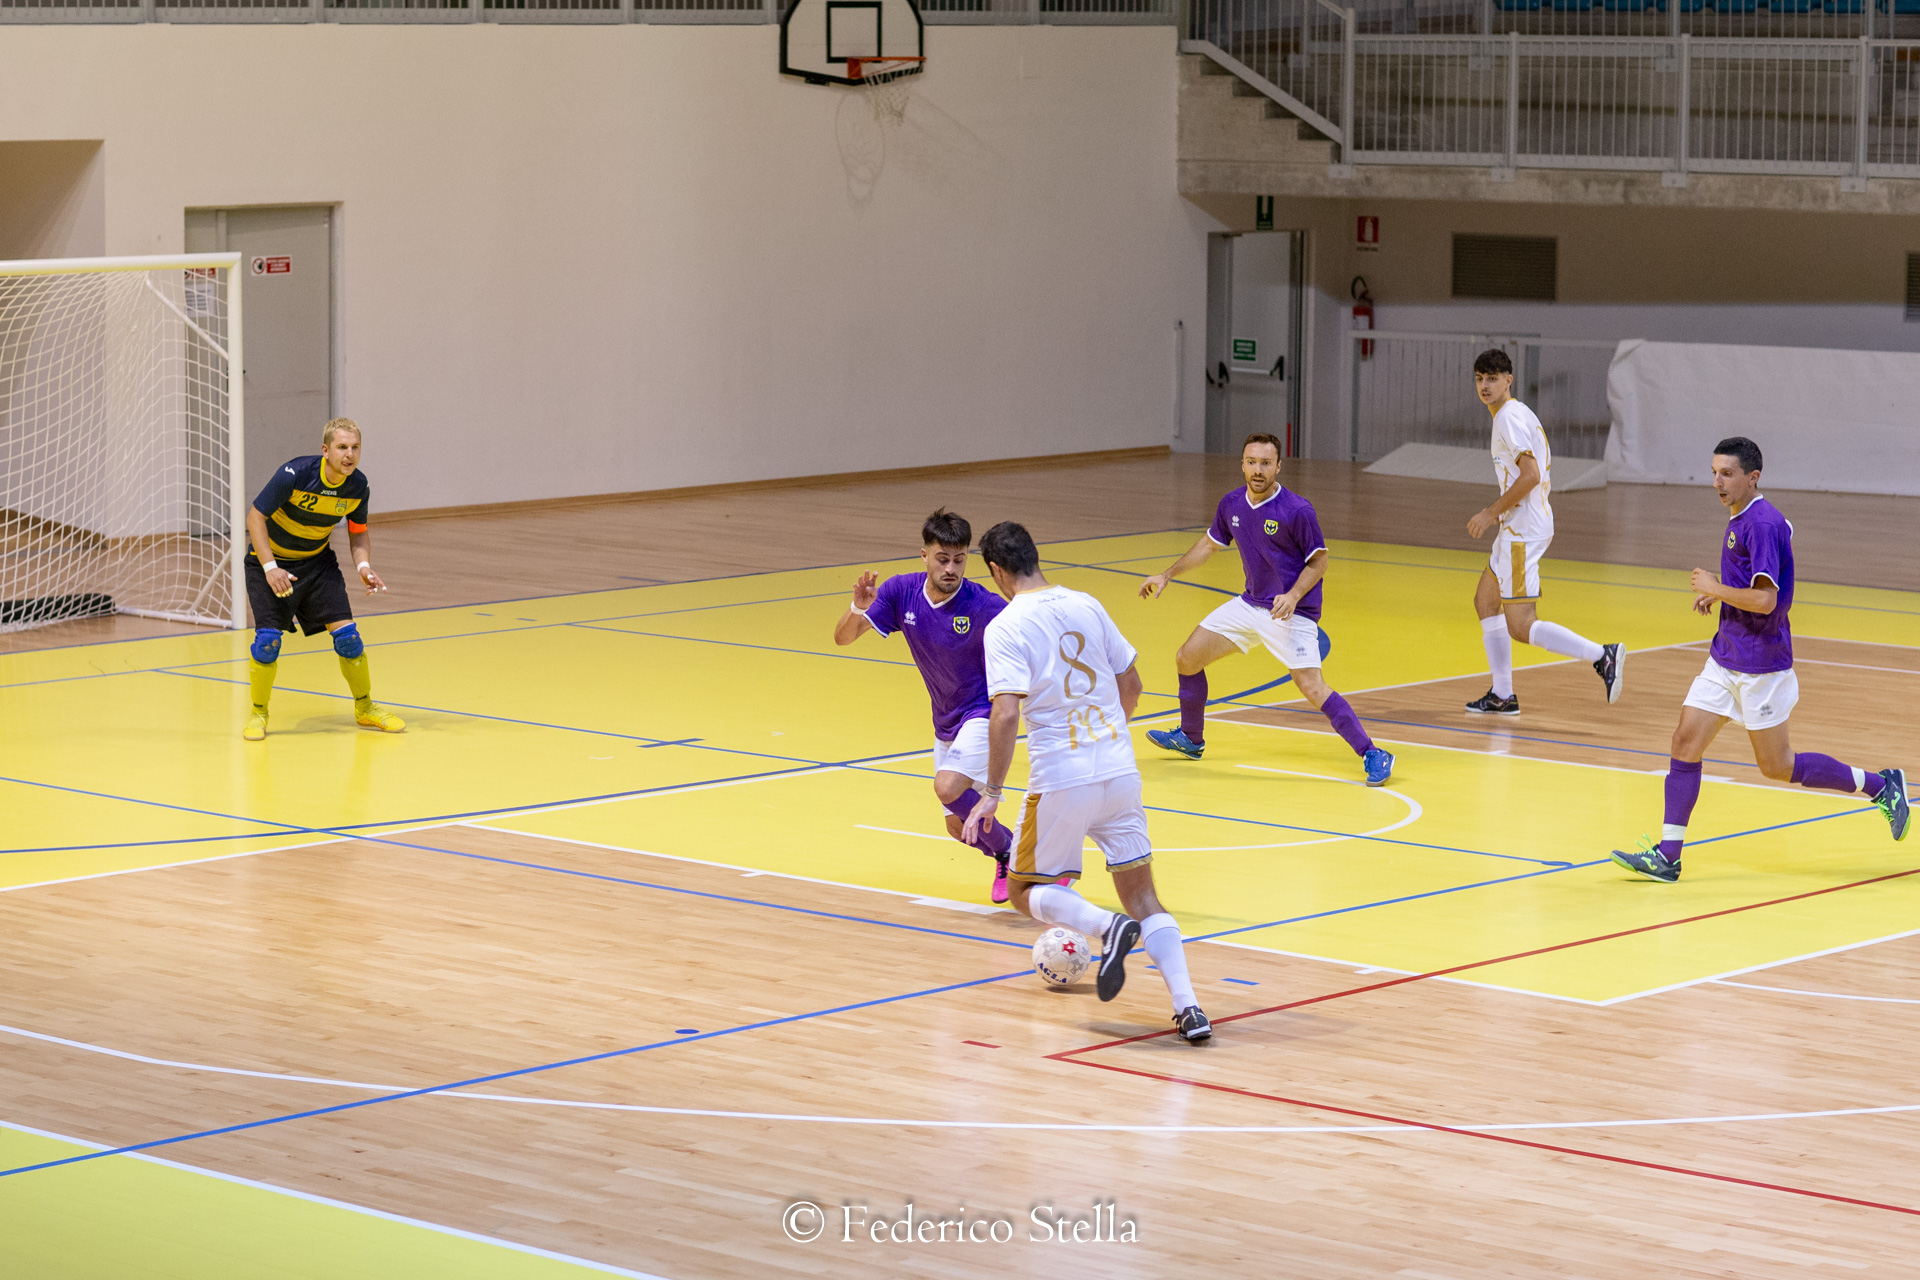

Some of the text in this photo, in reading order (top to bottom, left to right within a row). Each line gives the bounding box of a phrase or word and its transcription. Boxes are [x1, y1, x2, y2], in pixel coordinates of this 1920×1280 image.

[298, 493, 319, 511] 22
[1059, 630, 1097, 700] 8
[1037, 962, 1067, 984] AGLA
